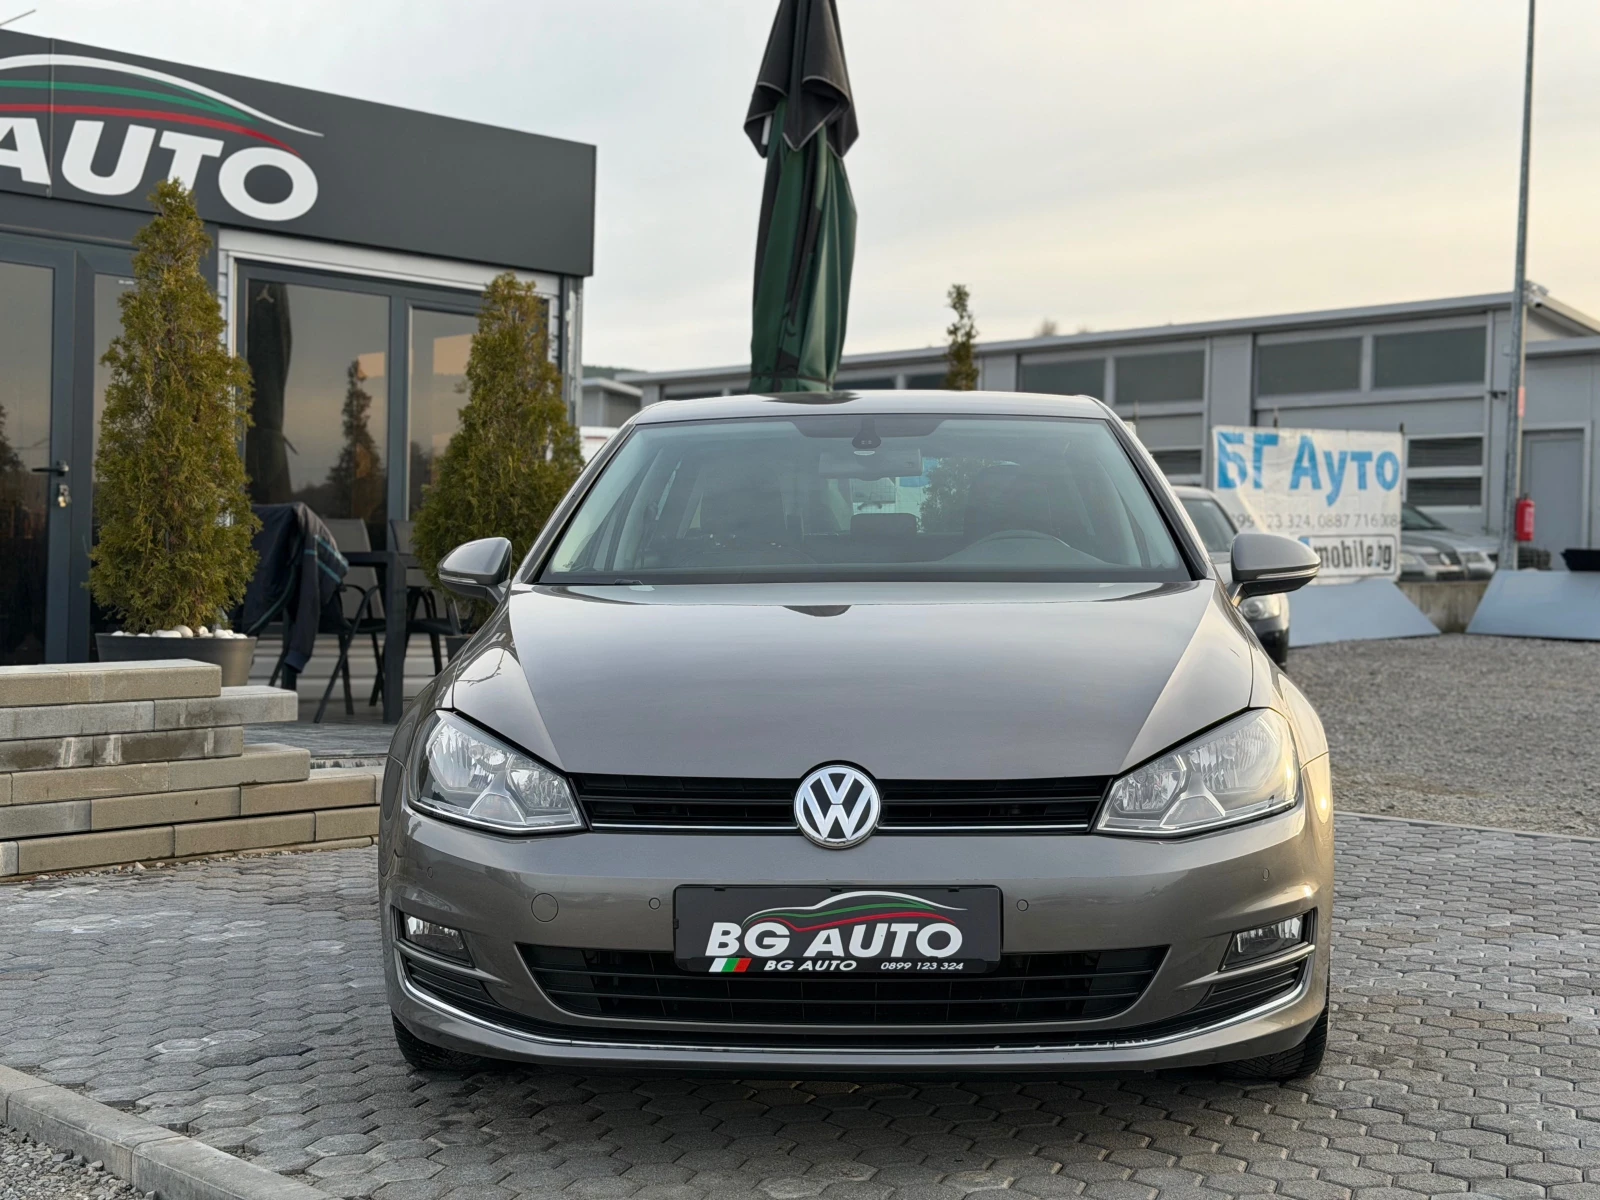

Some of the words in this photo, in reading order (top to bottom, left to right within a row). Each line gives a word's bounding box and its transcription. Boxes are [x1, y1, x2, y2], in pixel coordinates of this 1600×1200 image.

[0, 117, 319, 222] AUTO
[1289, 434, 1400, 508] Ауто
[704, 921, 791, 958] BG
[802, 921, 964, 958] AUTO
[763, 959, 796, 972] BG
[797, 959, 857, 972] AUTO
[880, 961, 912, 971] 0899
[915, 961, 938, 971] 123
[940, 961, 964, 971] 324
